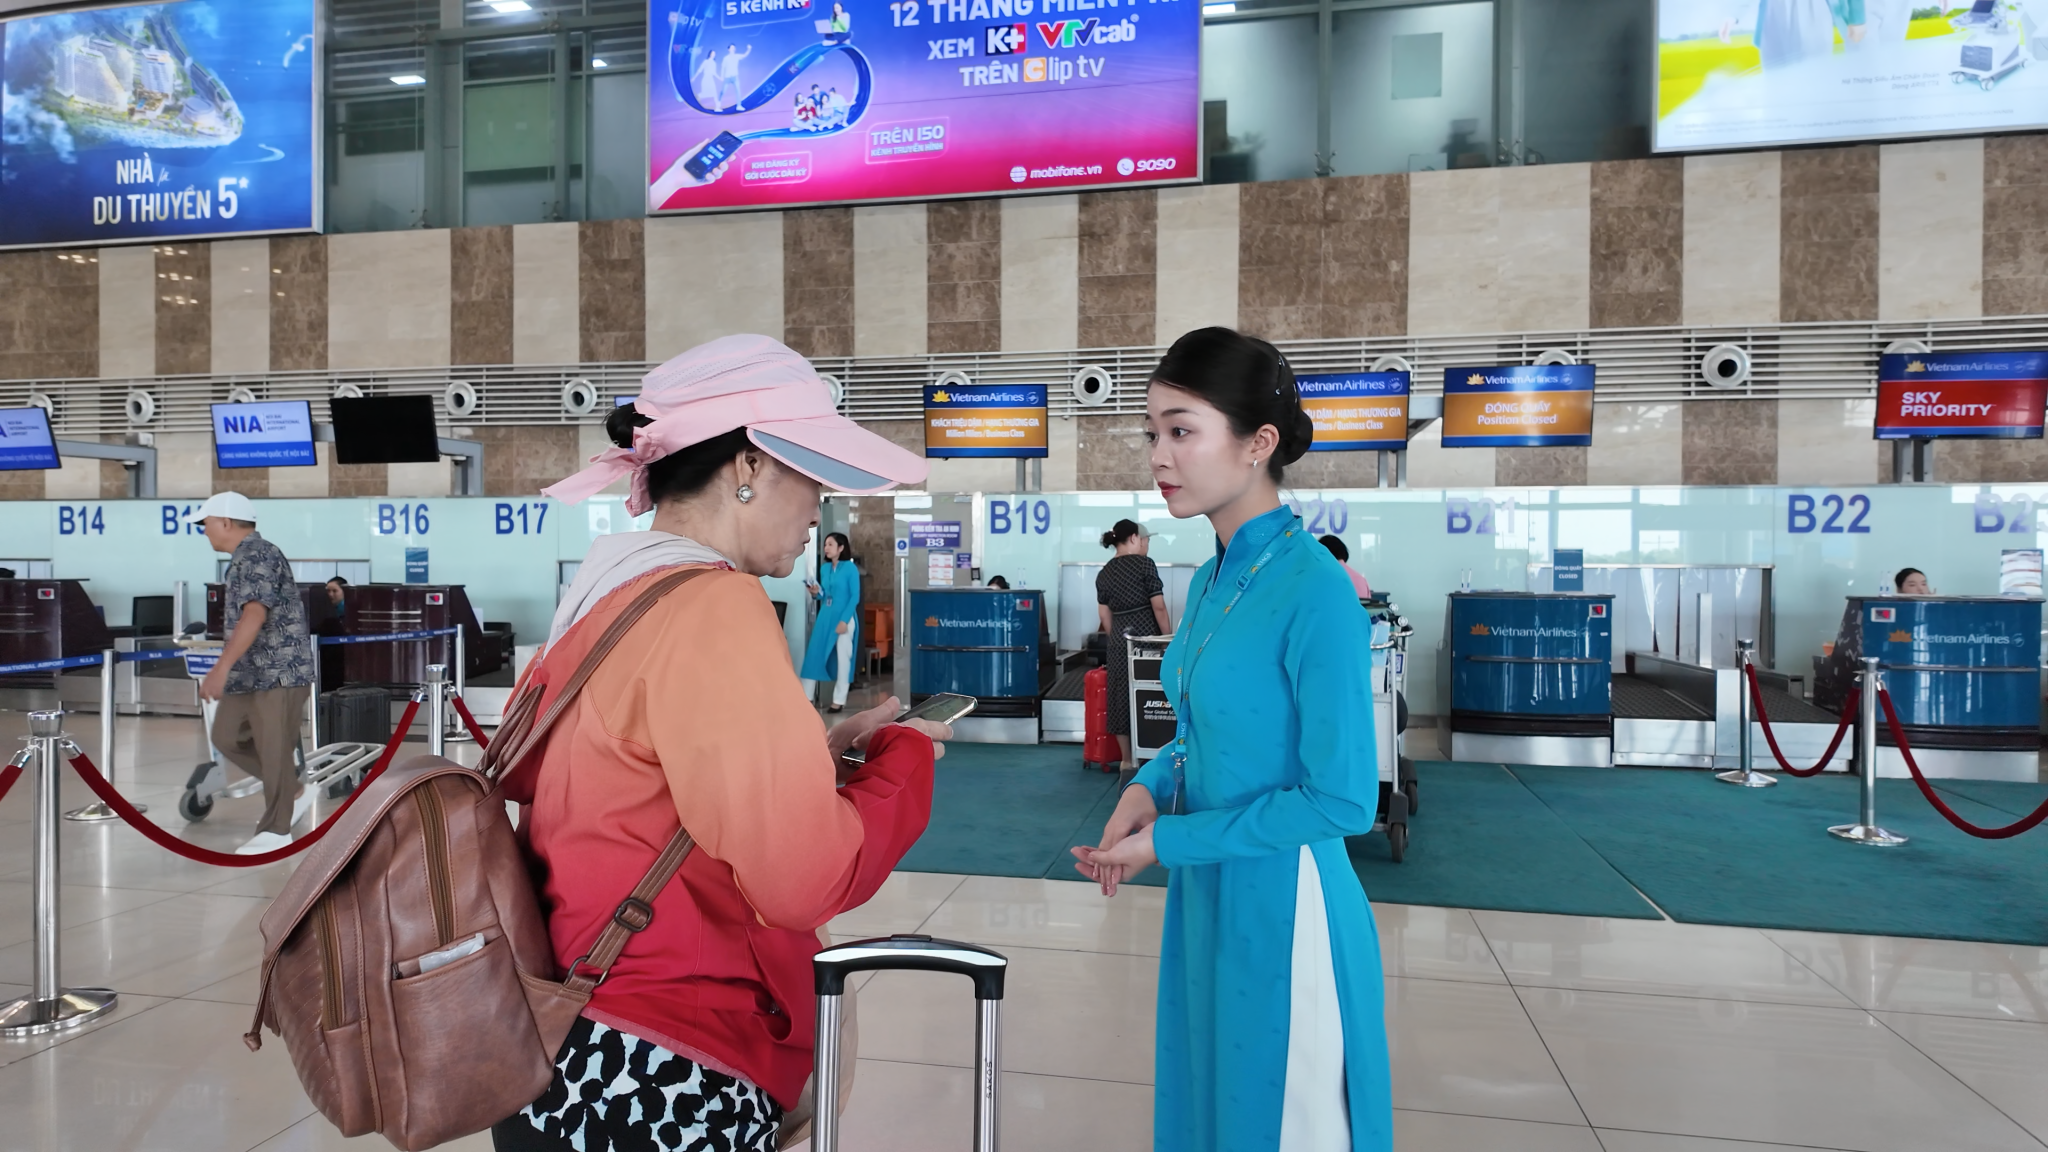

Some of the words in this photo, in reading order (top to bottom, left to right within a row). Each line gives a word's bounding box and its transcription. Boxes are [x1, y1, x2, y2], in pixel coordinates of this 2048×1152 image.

[726, 1, 738, 16] 5
[889, 2, 920, 28] 12
[927, 37, 975, 61] XEM
[986, 25, 1026, 54] K+
[959, 60, 1019, 87] TRÊN
[1023, 57, 1074, 85] Clip
[1077, 54, 1106, 78] tv
[870, 126, 914, 146] TRÊN
[917, 125, 945, 142] 150
[116, 151, 154, 185] NHÀ
[1029, 164, 1103, 179] mobifone.vn
[1136, 157, 1177, 172] 9090
[93, 194, 122, 226] DU
[126, 183, 212, 224] THUYỀN
[1484, 401, 1519, 414] ĐÓNG
[1901, 391, 1942, 404] SKY
[1388, 406, 1402, 418] GIA
[1477, 415, 1519, 426] Position
[1521, 413, 1557, 425] Closed
[1899, 403, 1993, 417] PRIORITY
[223, 415, 263, 434] NIA
[1009, 429, 1025, 438] Class
[1337, 420, 1365, 431] Business
[1366, 419, 1384, 430] Class
[59, 504, 105, 536] B14
[378, 503, 430, 536] B16
[495, 502, 549, 536] B17
[990, 500, 1051, 535] B19
[1446, 496, 1516, 535] B21
[1787, 494, 1871, 534] B22
[925, 538, 945, 547] B3
[37, 659, 65, 669] AIRPORT
